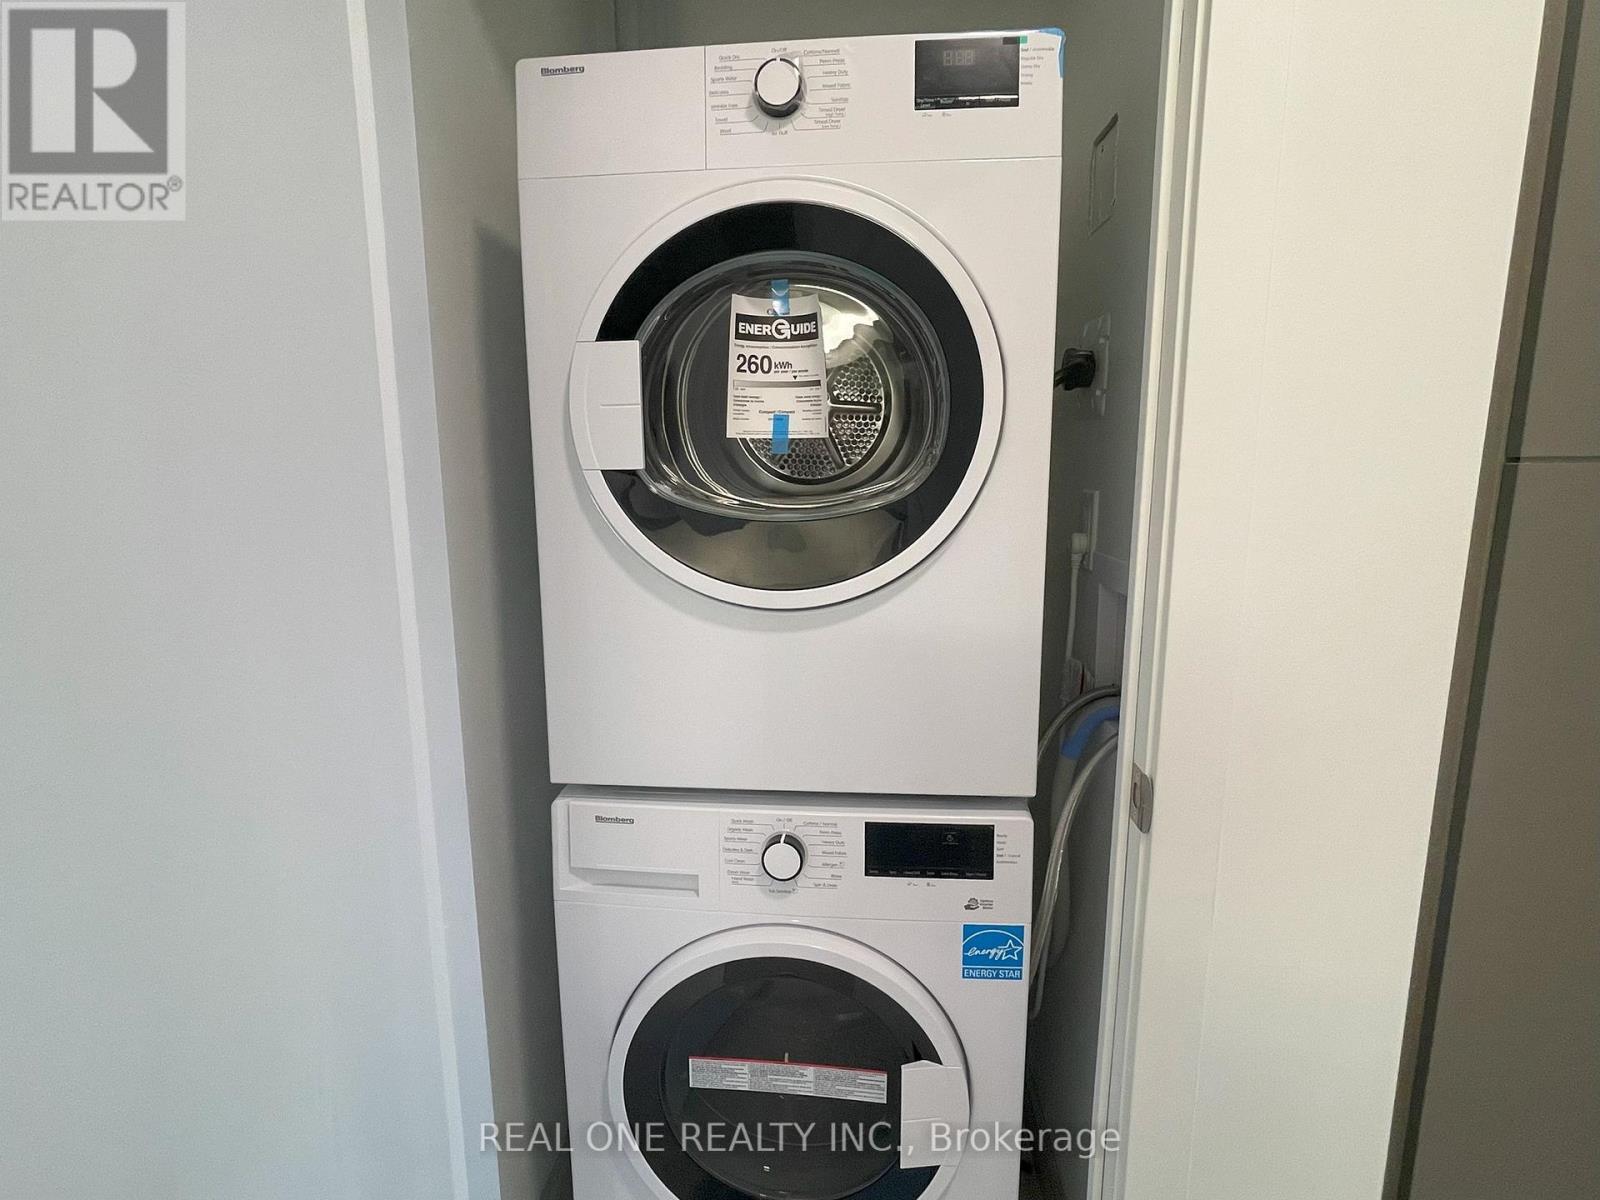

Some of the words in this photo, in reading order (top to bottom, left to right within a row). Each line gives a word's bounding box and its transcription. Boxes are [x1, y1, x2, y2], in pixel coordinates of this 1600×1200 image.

[541, 66, 585, 76] Blomberg
[738, 318, 817, 340] ENERGUIDE
[736, 353, 773, 375] 260
[774, 361, 793, 370] kWh
[594, 815, 635, 825] Blomberg
[965, 947, 1004, 961] energy
[963, 968, 998, 978] ENERGY
[999, 969, 1021, 979] STAR
